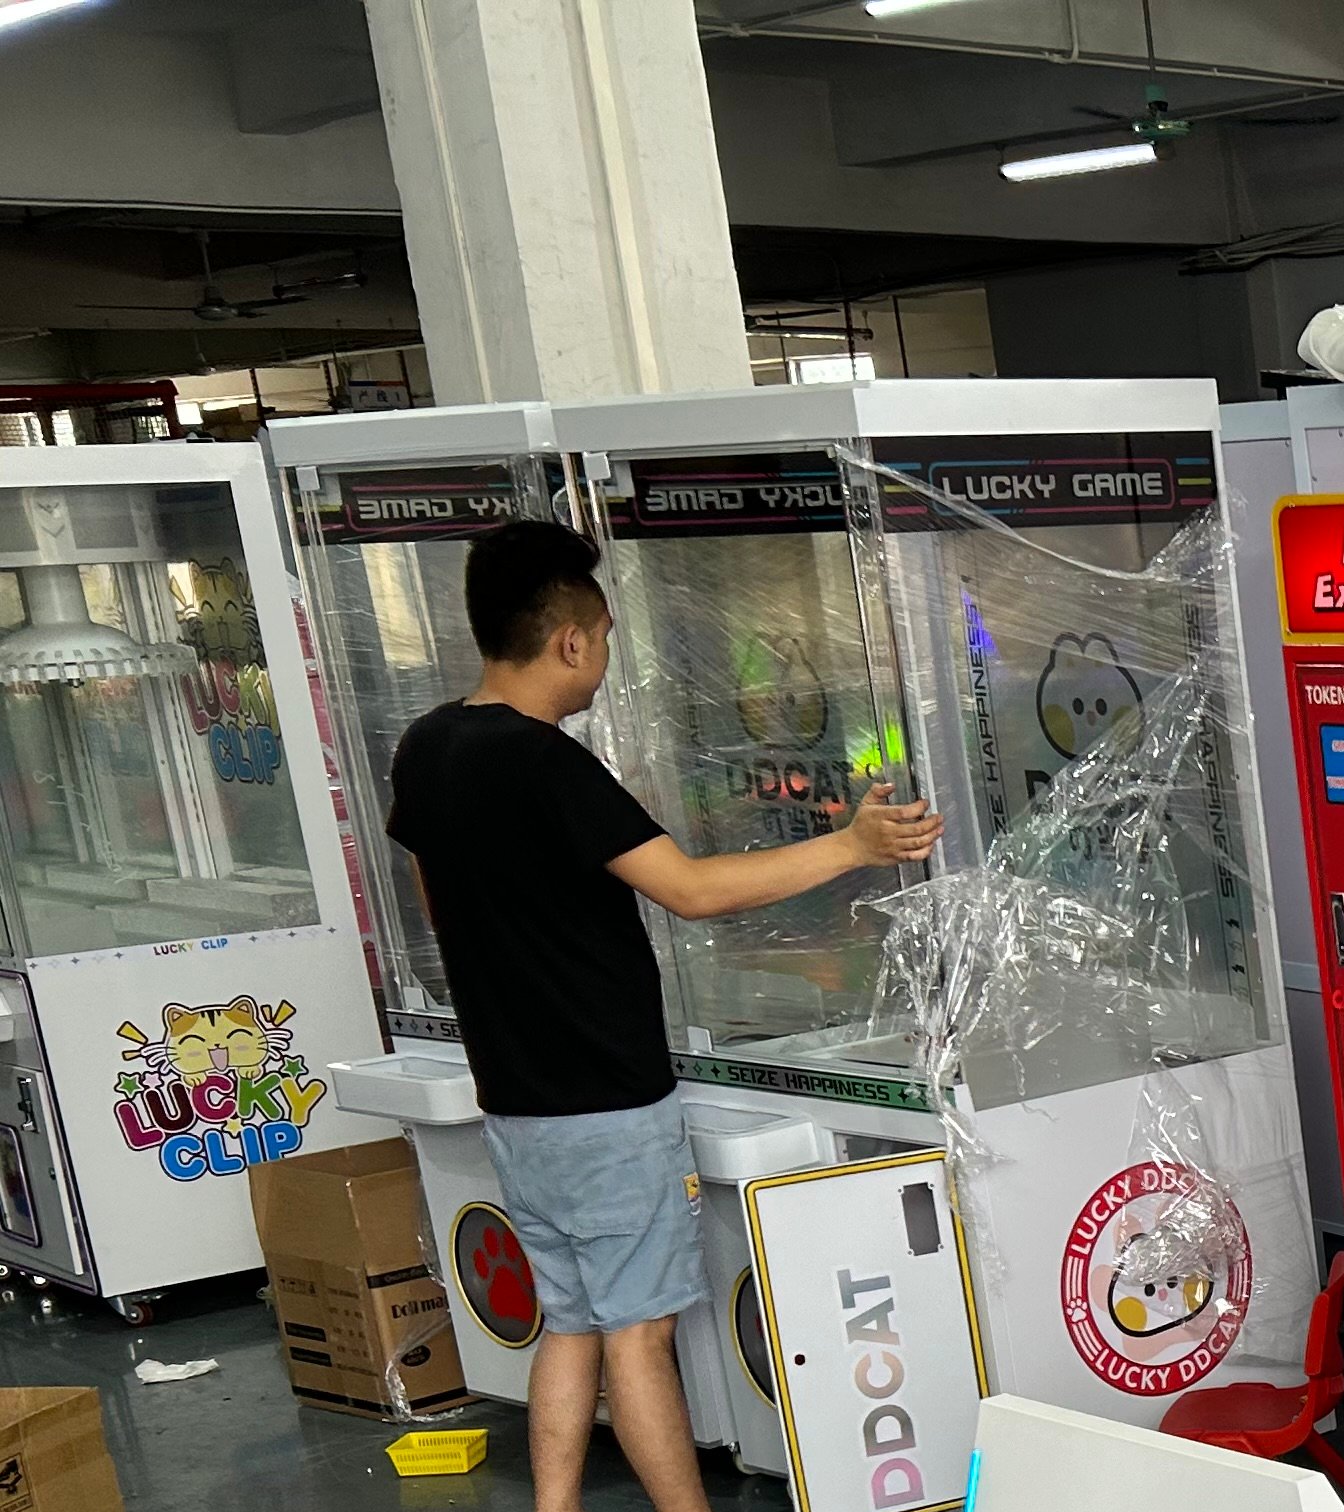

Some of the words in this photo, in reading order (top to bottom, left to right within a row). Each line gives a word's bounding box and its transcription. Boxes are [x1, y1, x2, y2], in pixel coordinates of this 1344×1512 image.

[942, 474, 1056, 500] LUCKY
[1072, 472, 1164, 497] GAME
[965, 604, 999, 782] HAPPINESS
[208, 722, 280, 785] CLIP
[154, 942, 195, 956] LUCKY
[201, 938, 228, 951] CLIP
[440, 1022, 461, 1037] SE
[114, 1073, 327, 1152] LUCKY
[728, 1066, 779, 1087] SEIZE
[785, 1073, 890, 1101] HAPPINESS
[160, 1120, 303, 1182] CLIP
[1071, 1175, 1134, 1257] LUCKY
[836, 1268, 925, 1510] DDCAT
[1095, 1347, 1172, 1391] LUCKY
